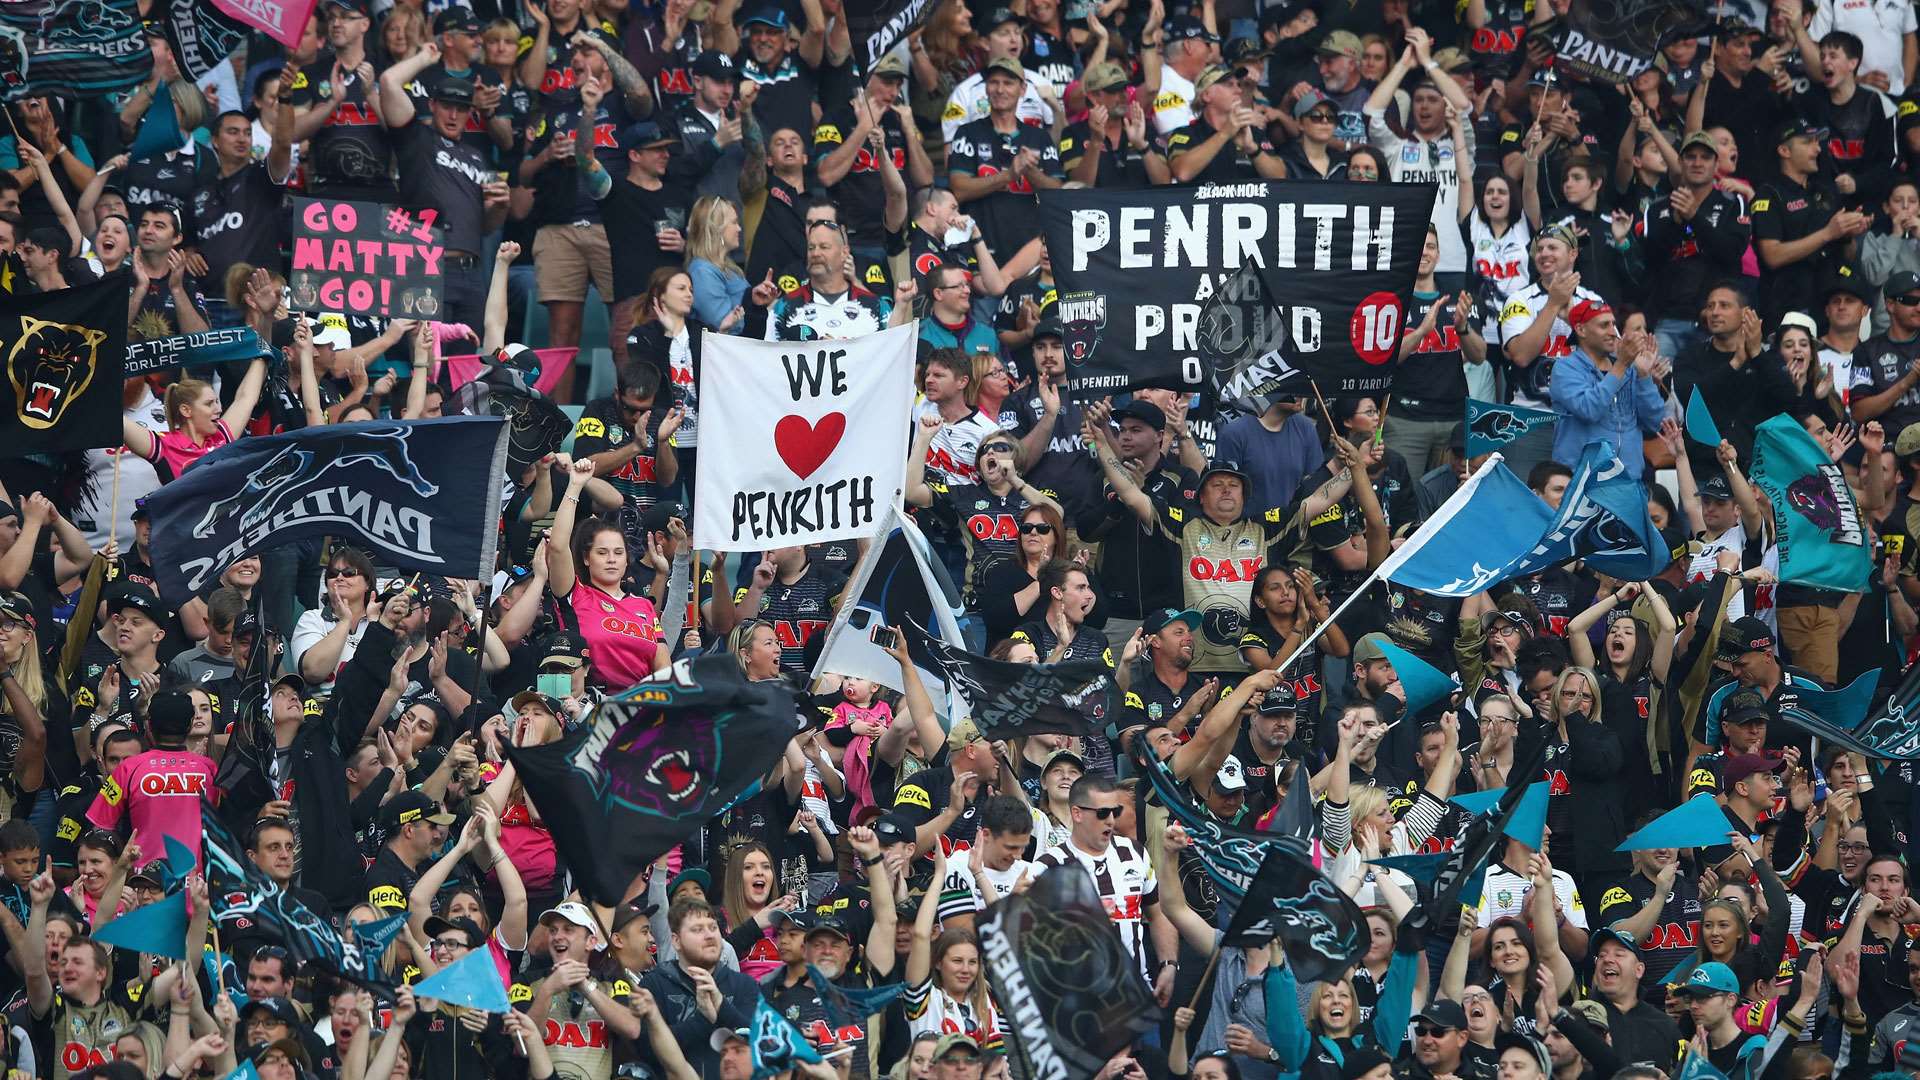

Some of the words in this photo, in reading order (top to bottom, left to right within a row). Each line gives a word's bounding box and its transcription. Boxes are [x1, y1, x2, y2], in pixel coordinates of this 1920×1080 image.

[303, 201, 358, 233] GO
[385, 206, 440, 244] #1
[1071, 203, 1396, 272] PENRITH
[293, 237, 445, 276] MATTY
[319, 278, 392, 317] GO!
[146, 337, 186, 358] THE
[189, 329, 246, 348] WEST
[1362, 304, 1398, 351] 10
[781, 349, 848, 402] WE
[1082, 375, 1129, 390] PENRITH
[1358, 377, 1381, 390] YARD
[731, 475, 874, 542] PENRITH
[966, 514, 1020, 541] OA
[141, 772, 207, 797] OAK
